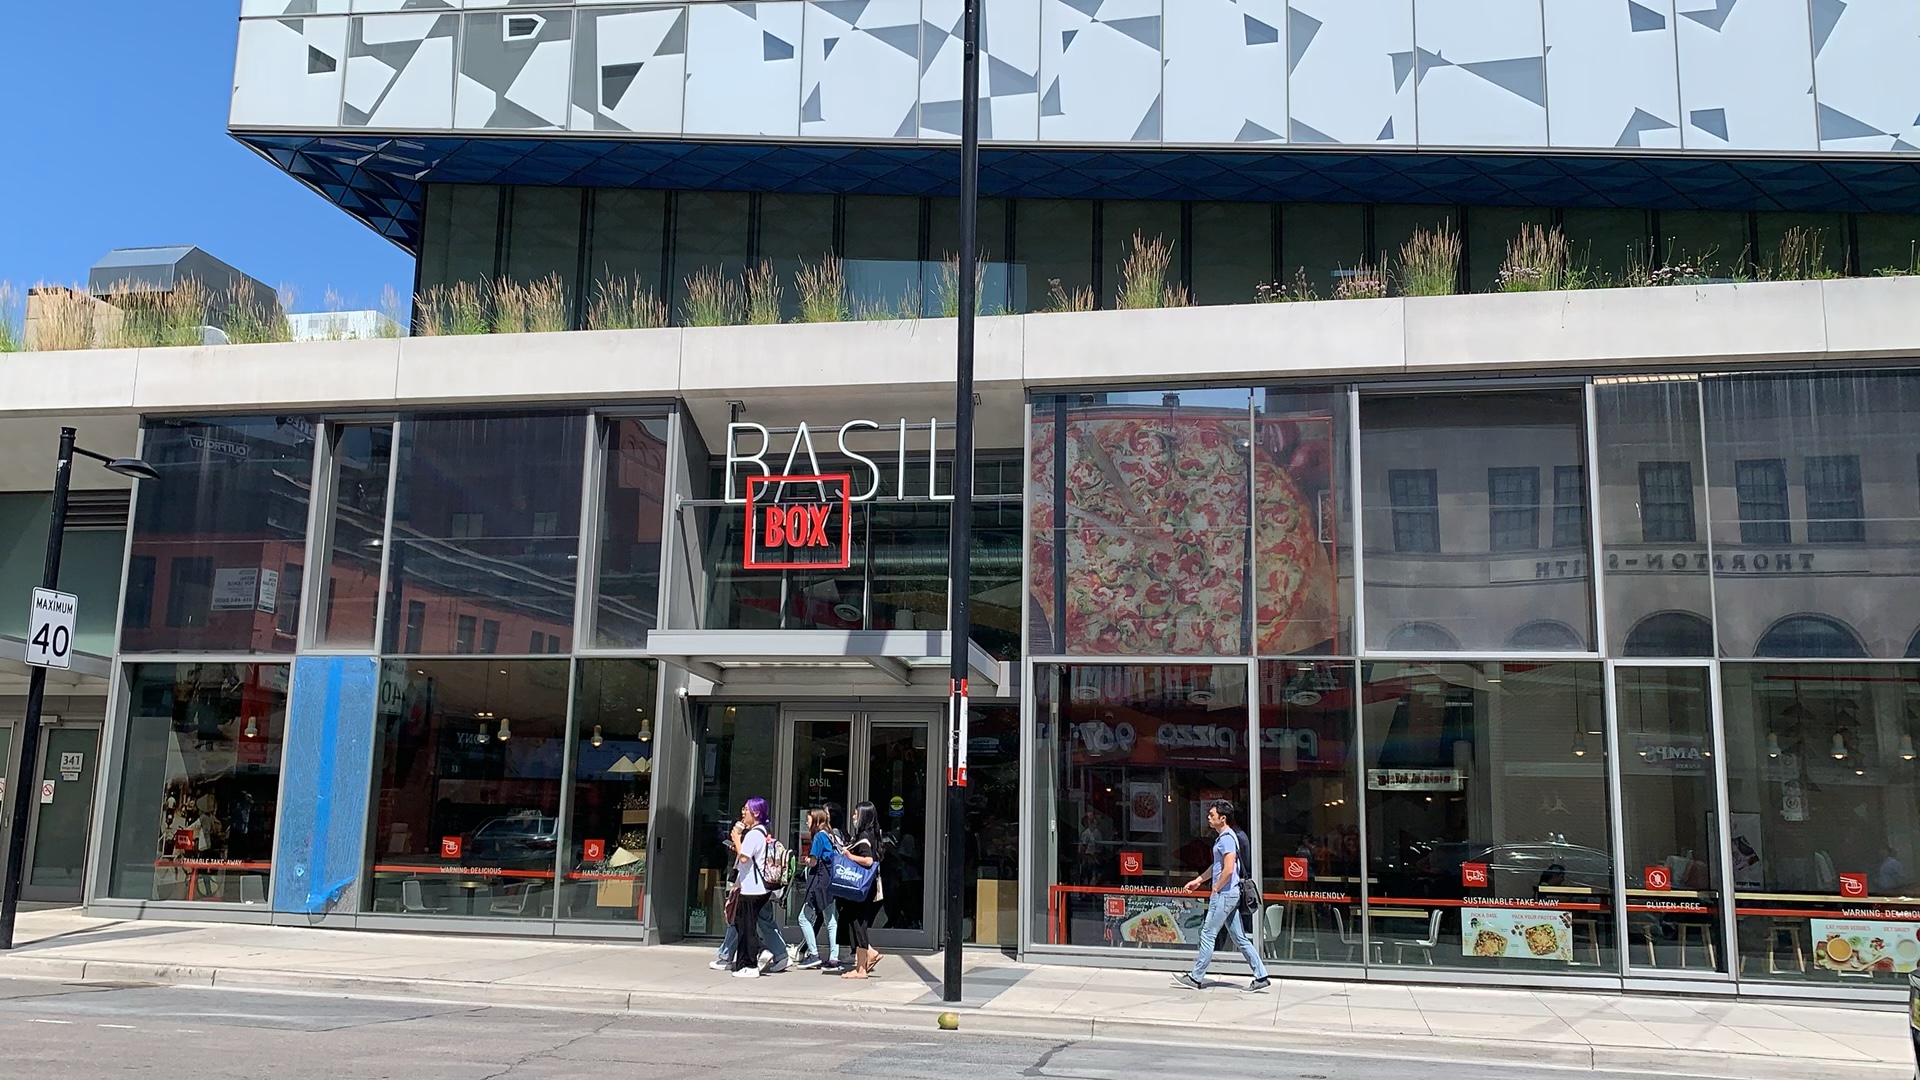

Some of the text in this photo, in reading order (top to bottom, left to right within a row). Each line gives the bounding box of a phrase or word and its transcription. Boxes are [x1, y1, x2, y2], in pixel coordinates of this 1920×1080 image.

[724, 417, 955, 504] BASIL
[765, 505, 830, 548] BOX
[36, 597, 73, 615] MAXIMUM
[31, 622, 70, 657] 40
[63, 756, 80, 764] 341
[809, 777, 831, 788] BASIL
[1310, 892, 1346, 900] FRIENDLY
[1463, 897, 1514, 905] SUSTAINABLE
[1841, 909, 1884, 917] WARNING:
